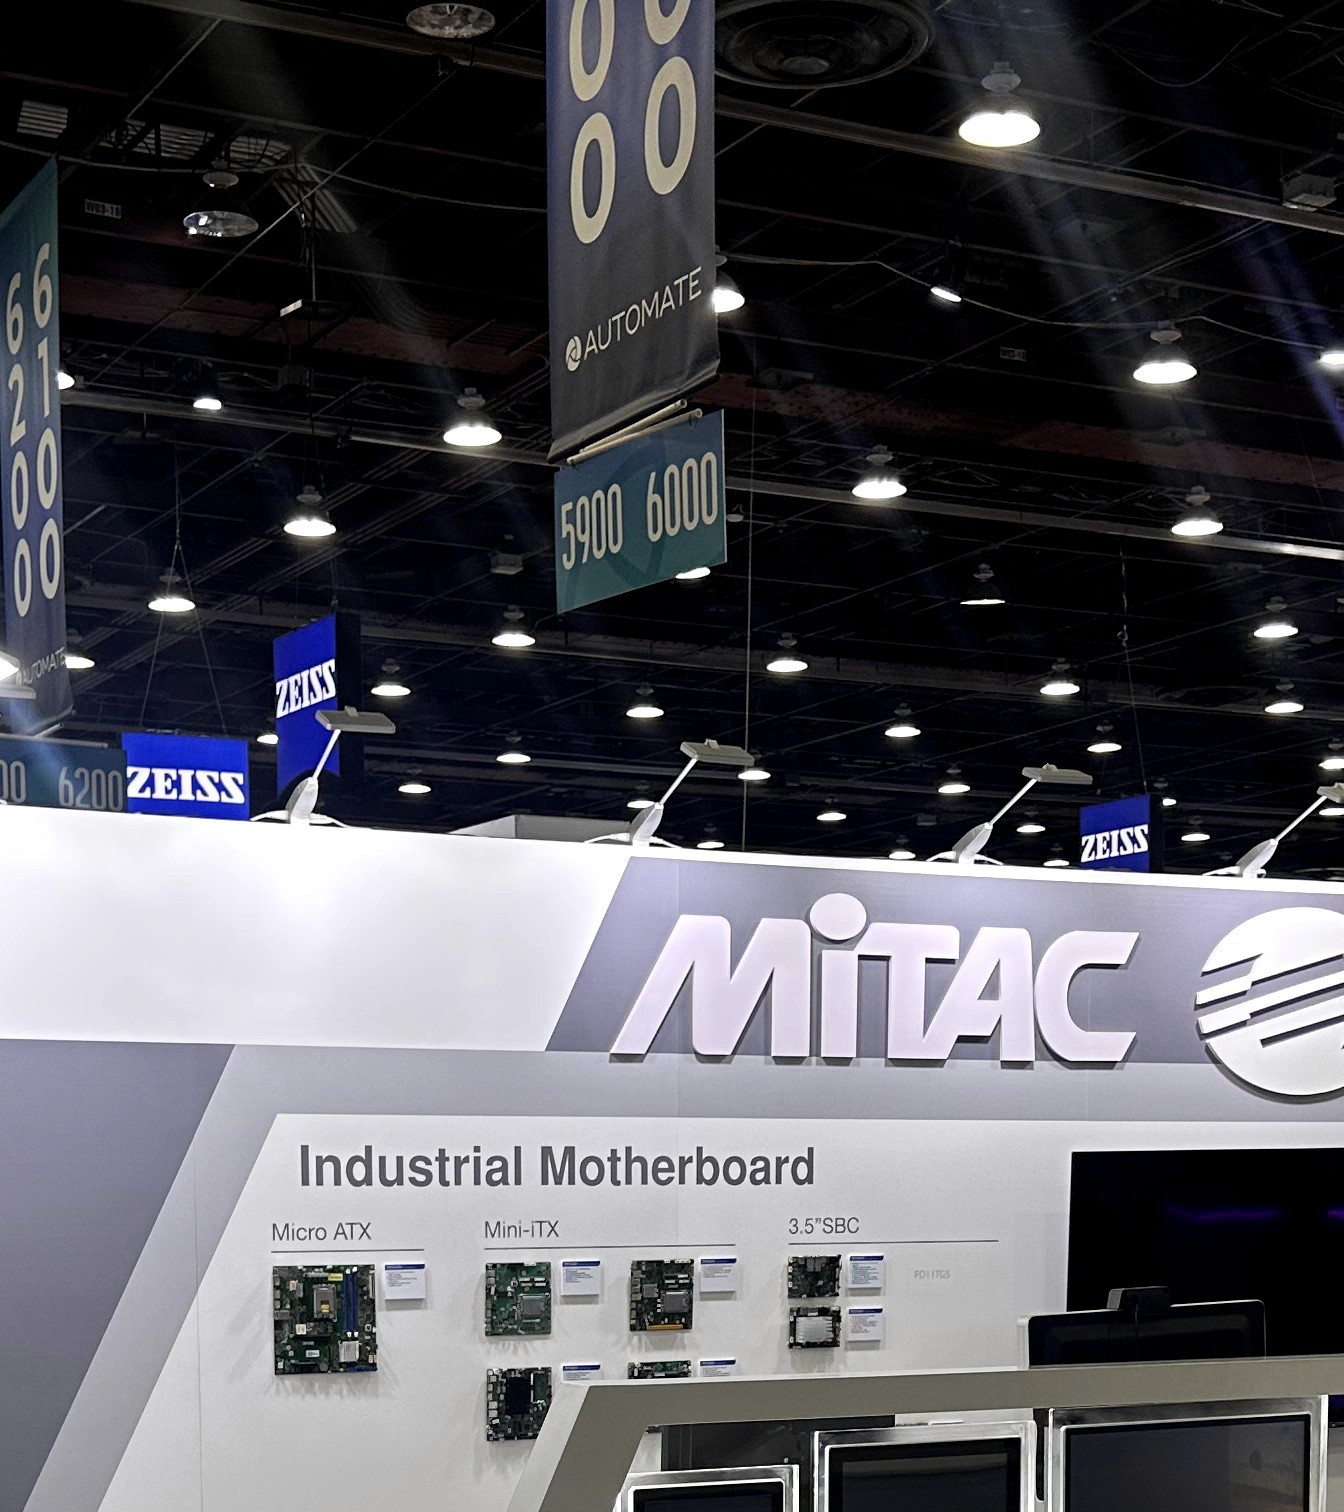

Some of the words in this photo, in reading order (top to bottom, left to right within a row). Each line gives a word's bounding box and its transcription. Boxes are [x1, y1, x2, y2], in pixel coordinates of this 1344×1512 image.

[584, 267, 703, 361] AUTOMATE
[561, 484, 624, 570] 5900
[647, 451, 719, 543] 6000
[276, 658, 336, 718] ZEISS
[58, 766, 124, 811] 6200
[126, 766, 245, 804] ZEISS
[1081, 823, 1149, 863] ZEISS
[300, 1145, 522, 1187] Industrial
[540, 1146, 815, 1187] Motherboard
[272, 1222, 328, 1242] Micro
[332, 1222, 373, 1242] ATX
